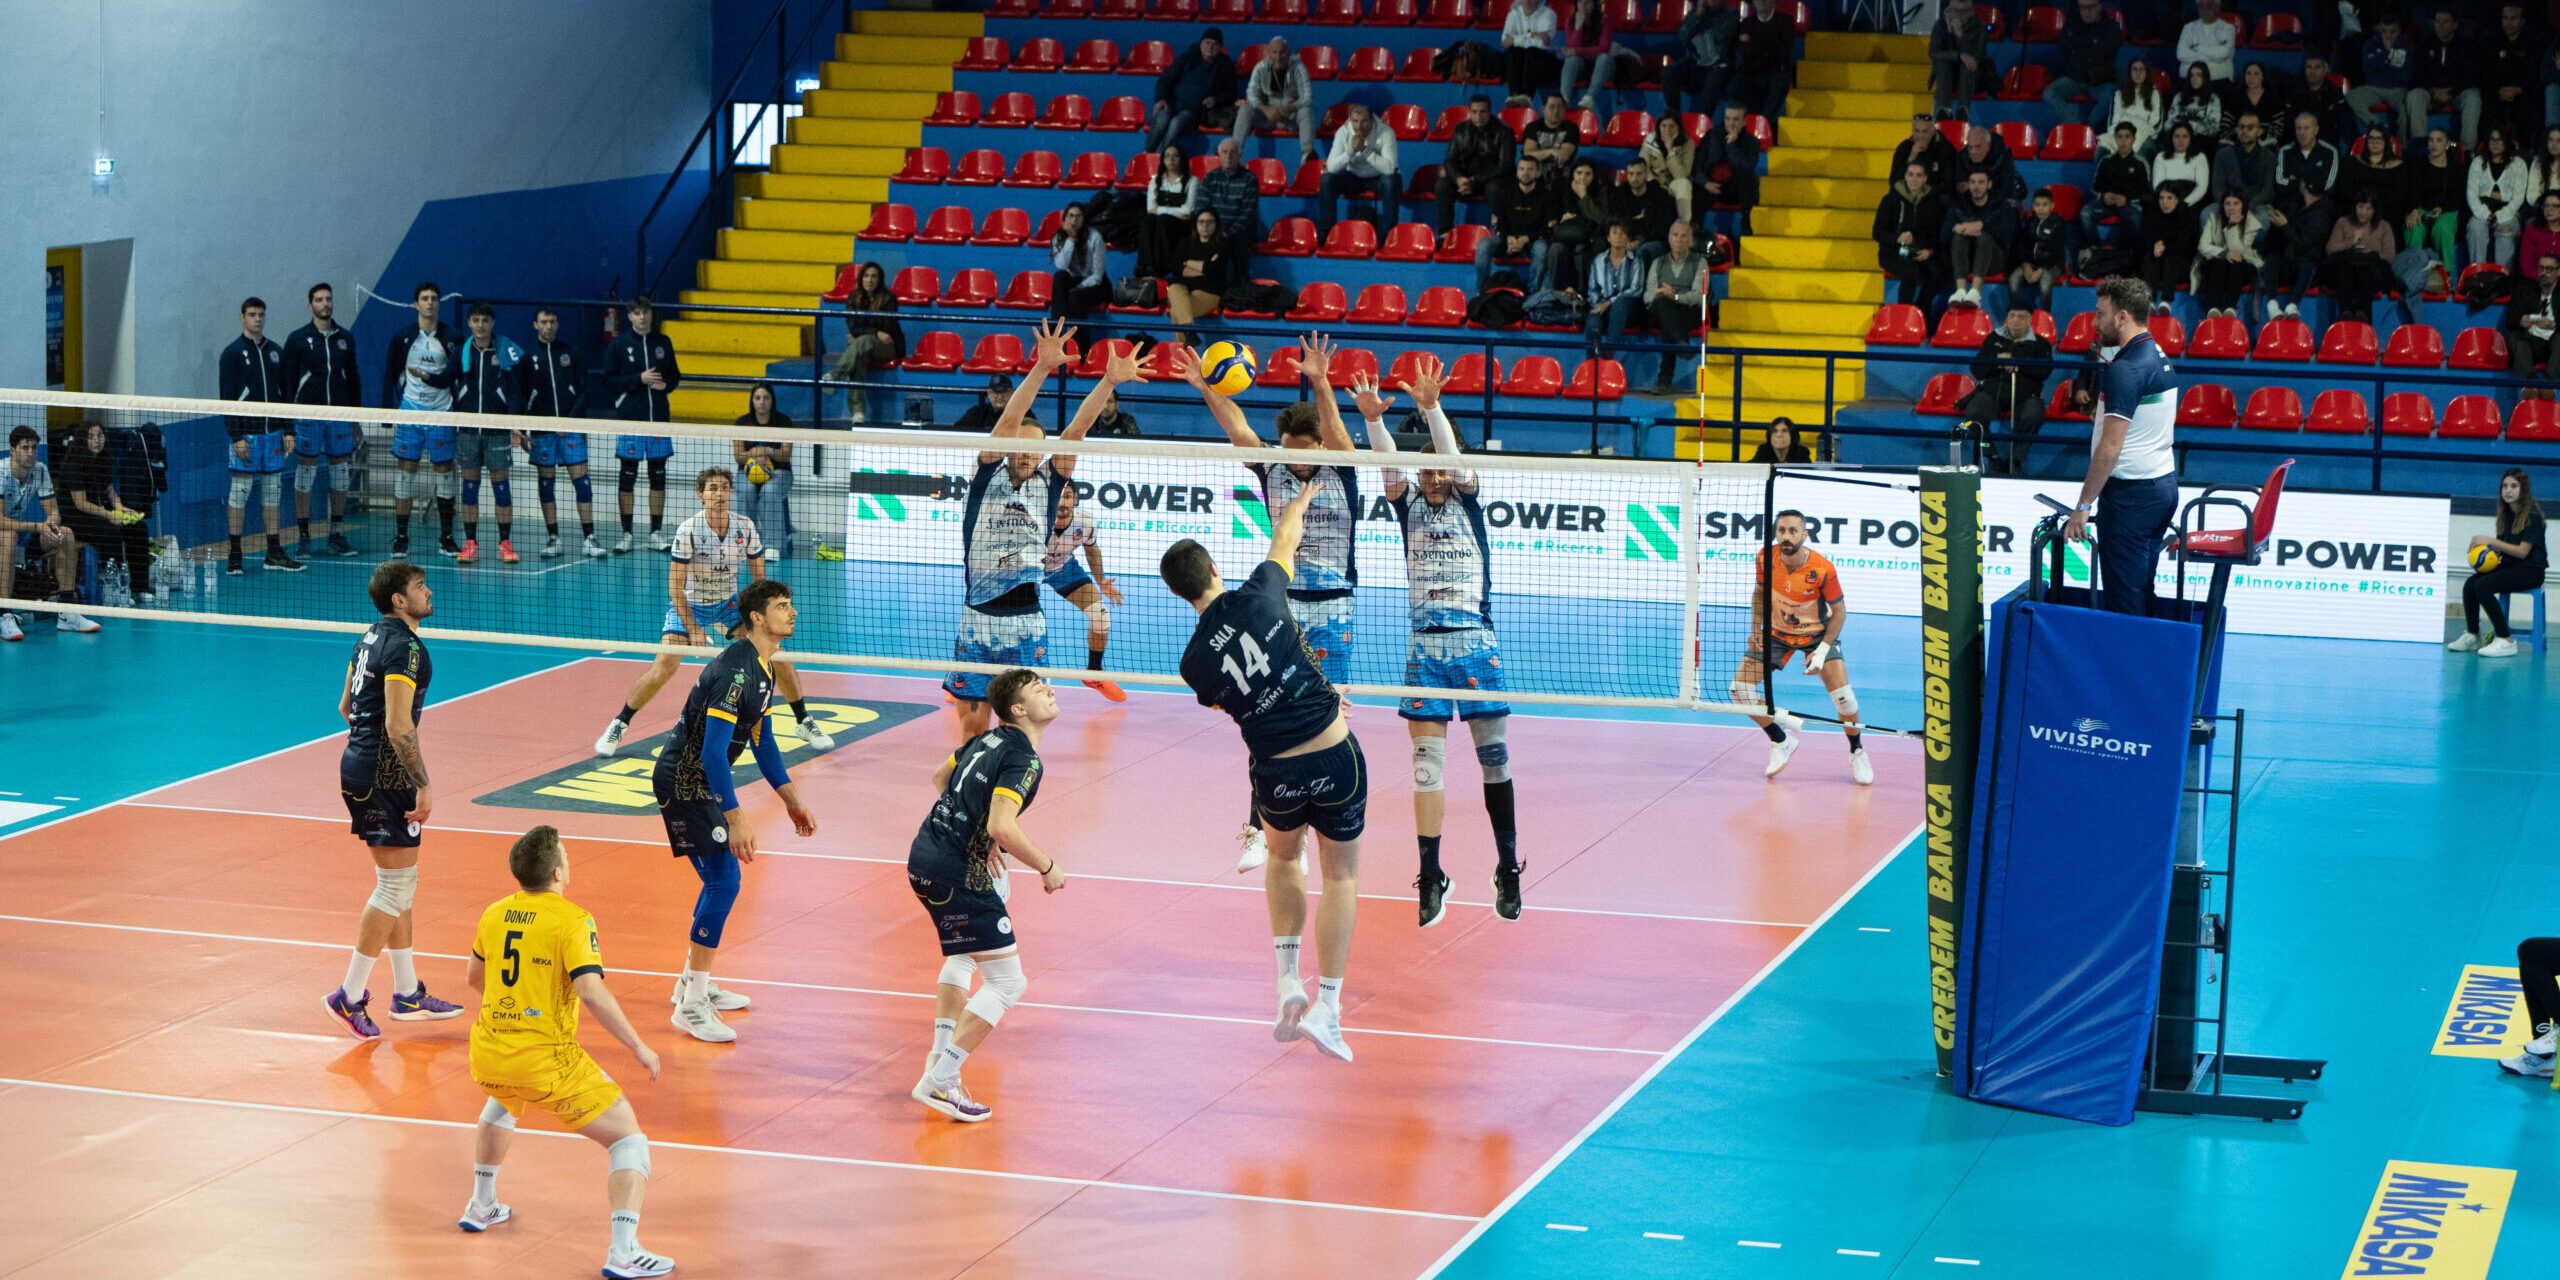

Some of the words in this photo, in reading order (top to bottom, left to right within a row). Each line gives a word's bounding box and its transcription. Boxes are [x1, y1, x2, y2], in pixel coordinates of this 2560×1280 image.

[1073, 481, 1214, 514] POWER
[1145, 519, 1212, 535] #Ricerca
[1486, 501, 1606, 533] OWER
[1705, 510, 1848, 545] SMRT
[1534, 537, 1604, 555] #Ricerca
[1827, 554, 1920, 571] Innovazion
[1920, 491, 1950, 612] BANCA
[2276, 539, 2437, 574] POWER
[2234, 575, 2350, 593] #Innovazione
[2358, 581, 2434, 597] #Ricerca
[1209, 623, 1237, 652] SALA
[1221, 631, 1272, 696] 14
[1924, 624, 1951, 762] CREDEM
[2029, 725, 2152, 757] VIVISPORT
[954, 750, 986, 793] 1
[1927, 783, 1954, 903] BANCA
[504, 909, 537, 925] DONATI
[501, 930, 523, 988] 5
[532, 956, 552, 966] MEKA
[1930, 916, 1957, 1050] CREDEM
[2443, 973, 2523, 1046] MIKASA
[2353, 1172, 2469, 1277] MIKASA
